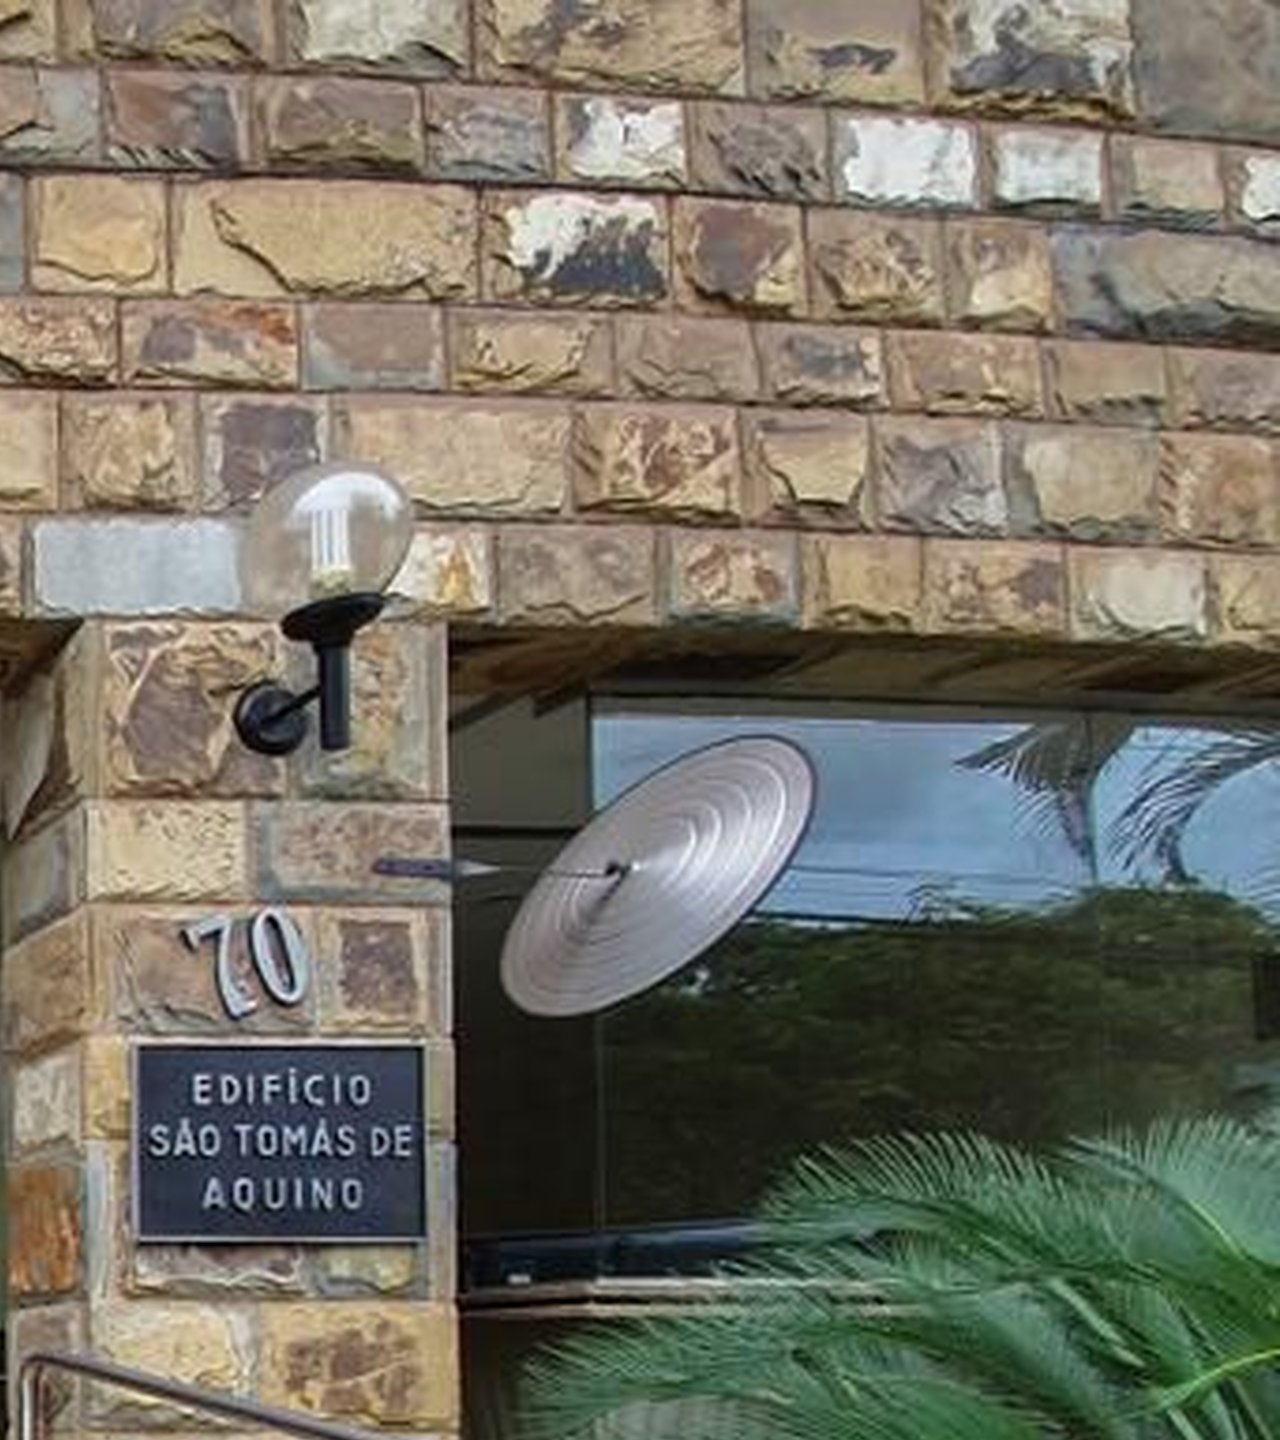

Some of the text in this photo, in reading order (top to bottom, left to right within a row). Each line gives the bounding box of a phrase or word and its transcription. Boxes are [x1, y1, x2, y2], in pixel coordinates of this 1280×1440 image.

[180, 905, 310, 1021] 70
[191, 1067, 372, 1105] EDIFÍCIO
[148, 1117, 413, 1156] SÃO TOMÁS DE
[201, 1176, 365, 1210] AQUINO
